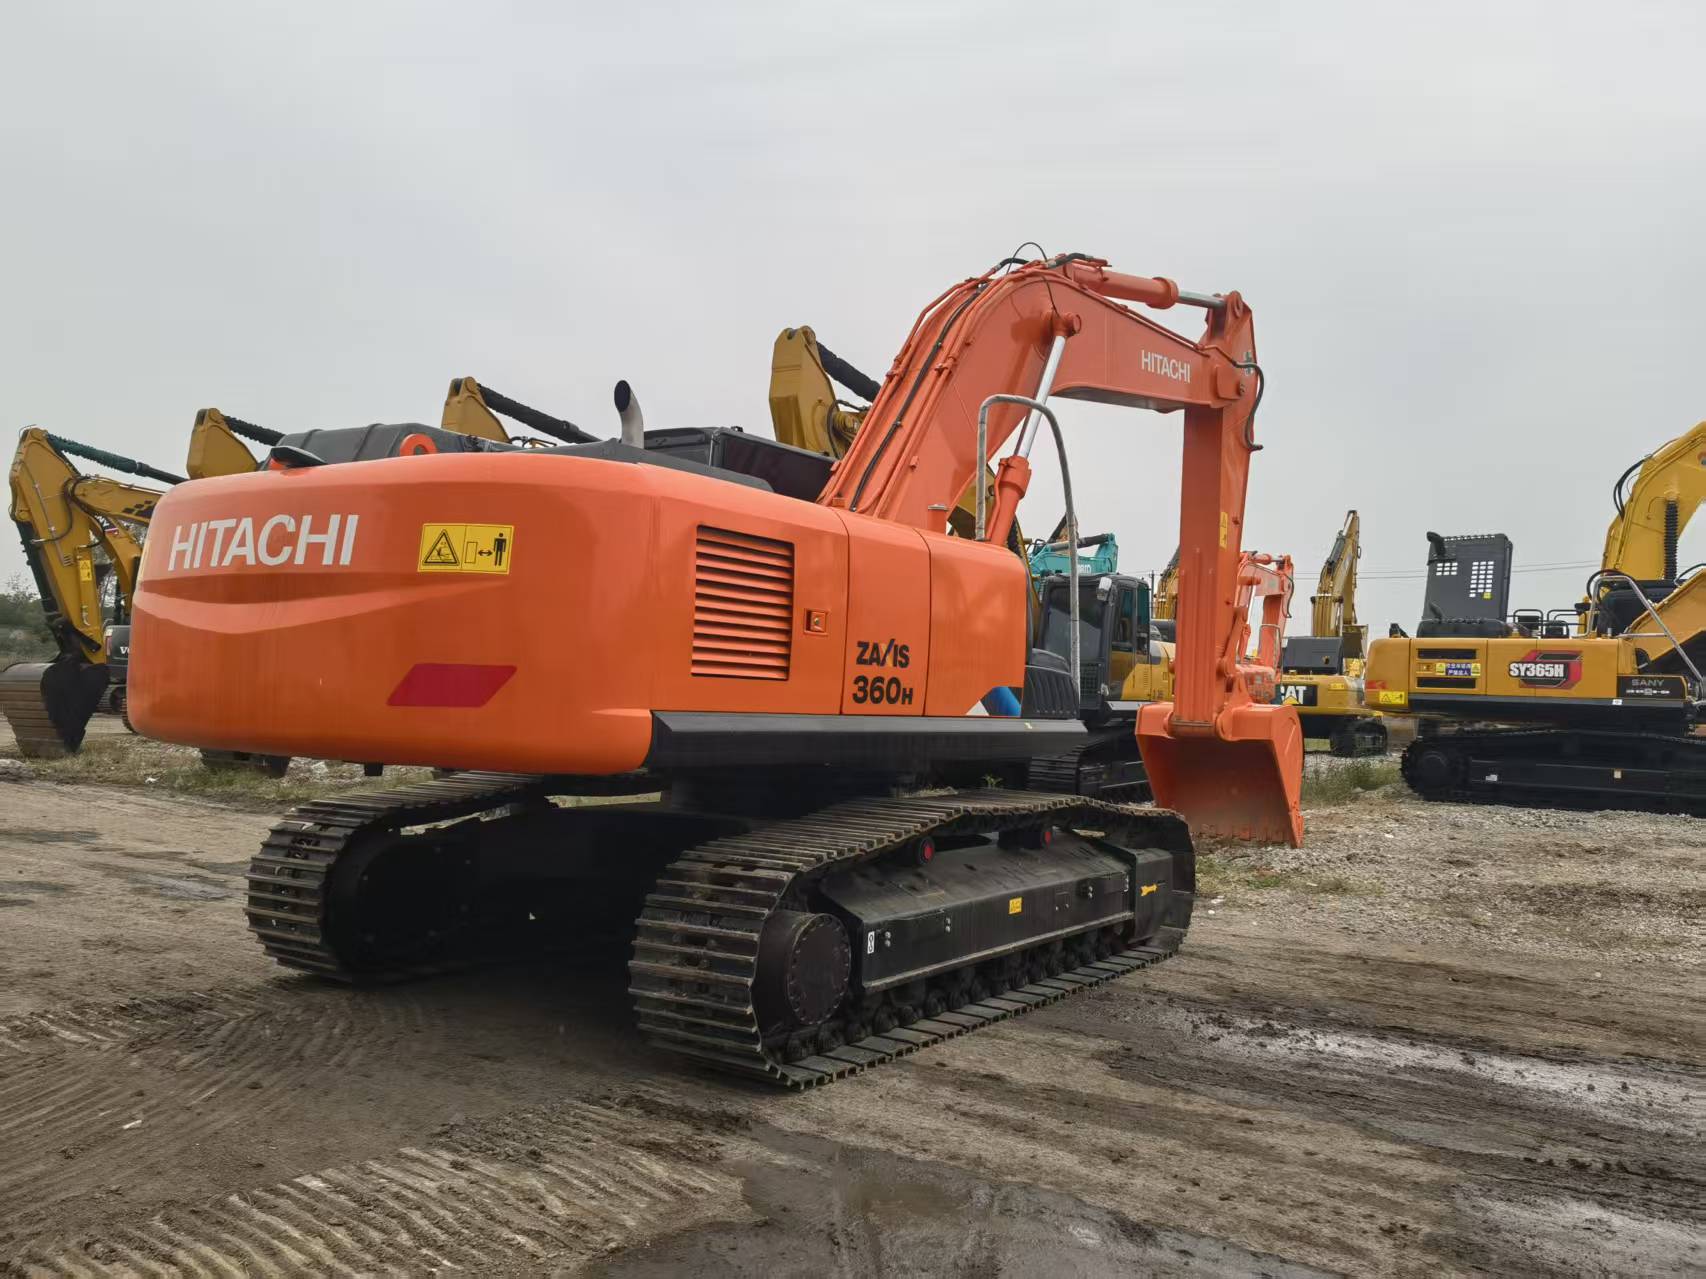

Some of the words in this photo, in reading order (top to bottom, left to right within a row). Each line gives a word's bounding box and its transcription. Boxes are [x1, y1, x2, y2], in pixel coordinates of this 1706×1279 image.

[1141, 350, 1191, 383] HITACHI
[167, 513, 359, 572] HITACHI
[1509, 662, 1565, 677] SY365H
[1631, 679, 1664, 687] SANY
[852, 675, 914, 705] 360H
